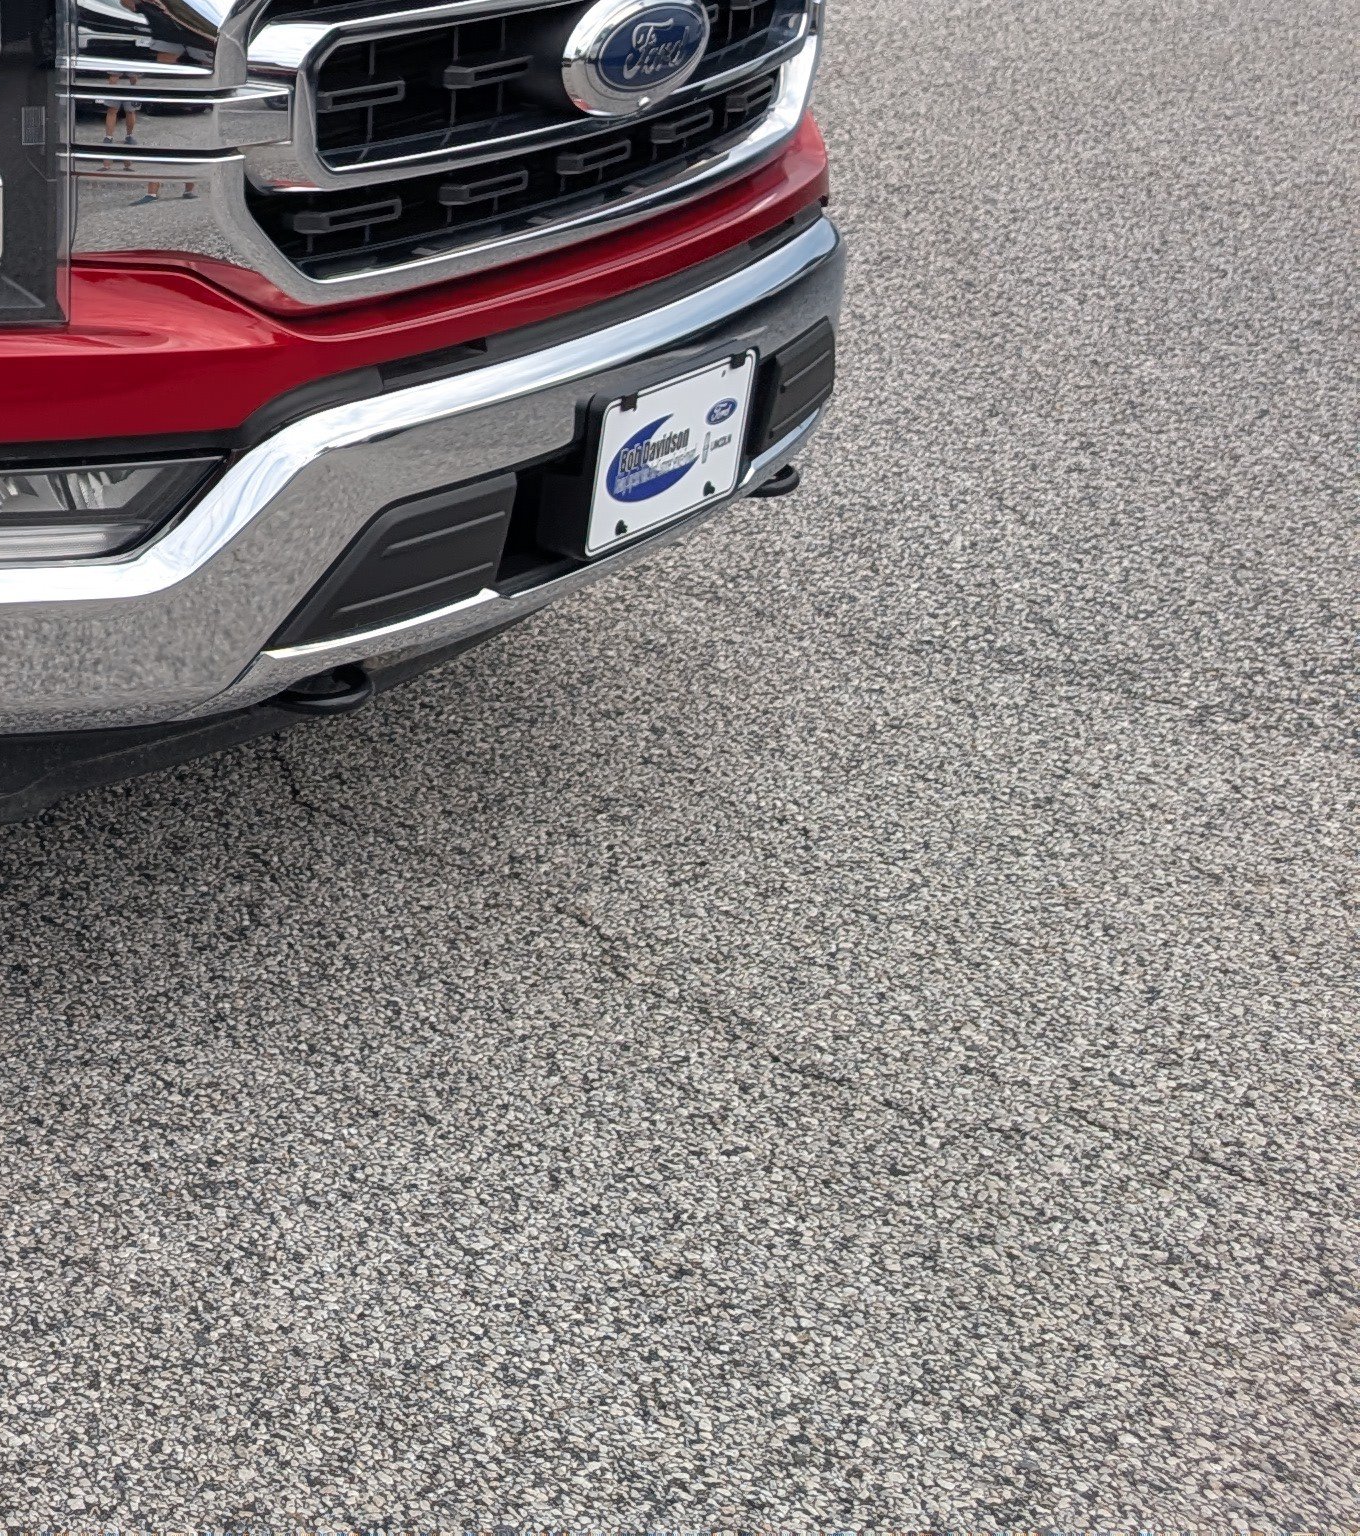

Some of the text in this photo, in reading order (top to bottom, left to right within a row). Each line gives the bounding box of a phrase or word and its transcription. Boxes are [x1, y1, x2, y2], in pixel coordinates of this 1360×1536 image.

[623, 18, 690, 80] Ford
[710, 401, 735, 422] Ford
[620, 441, 643, 473] Bob
[643, 428, 690, 464] Davidson
